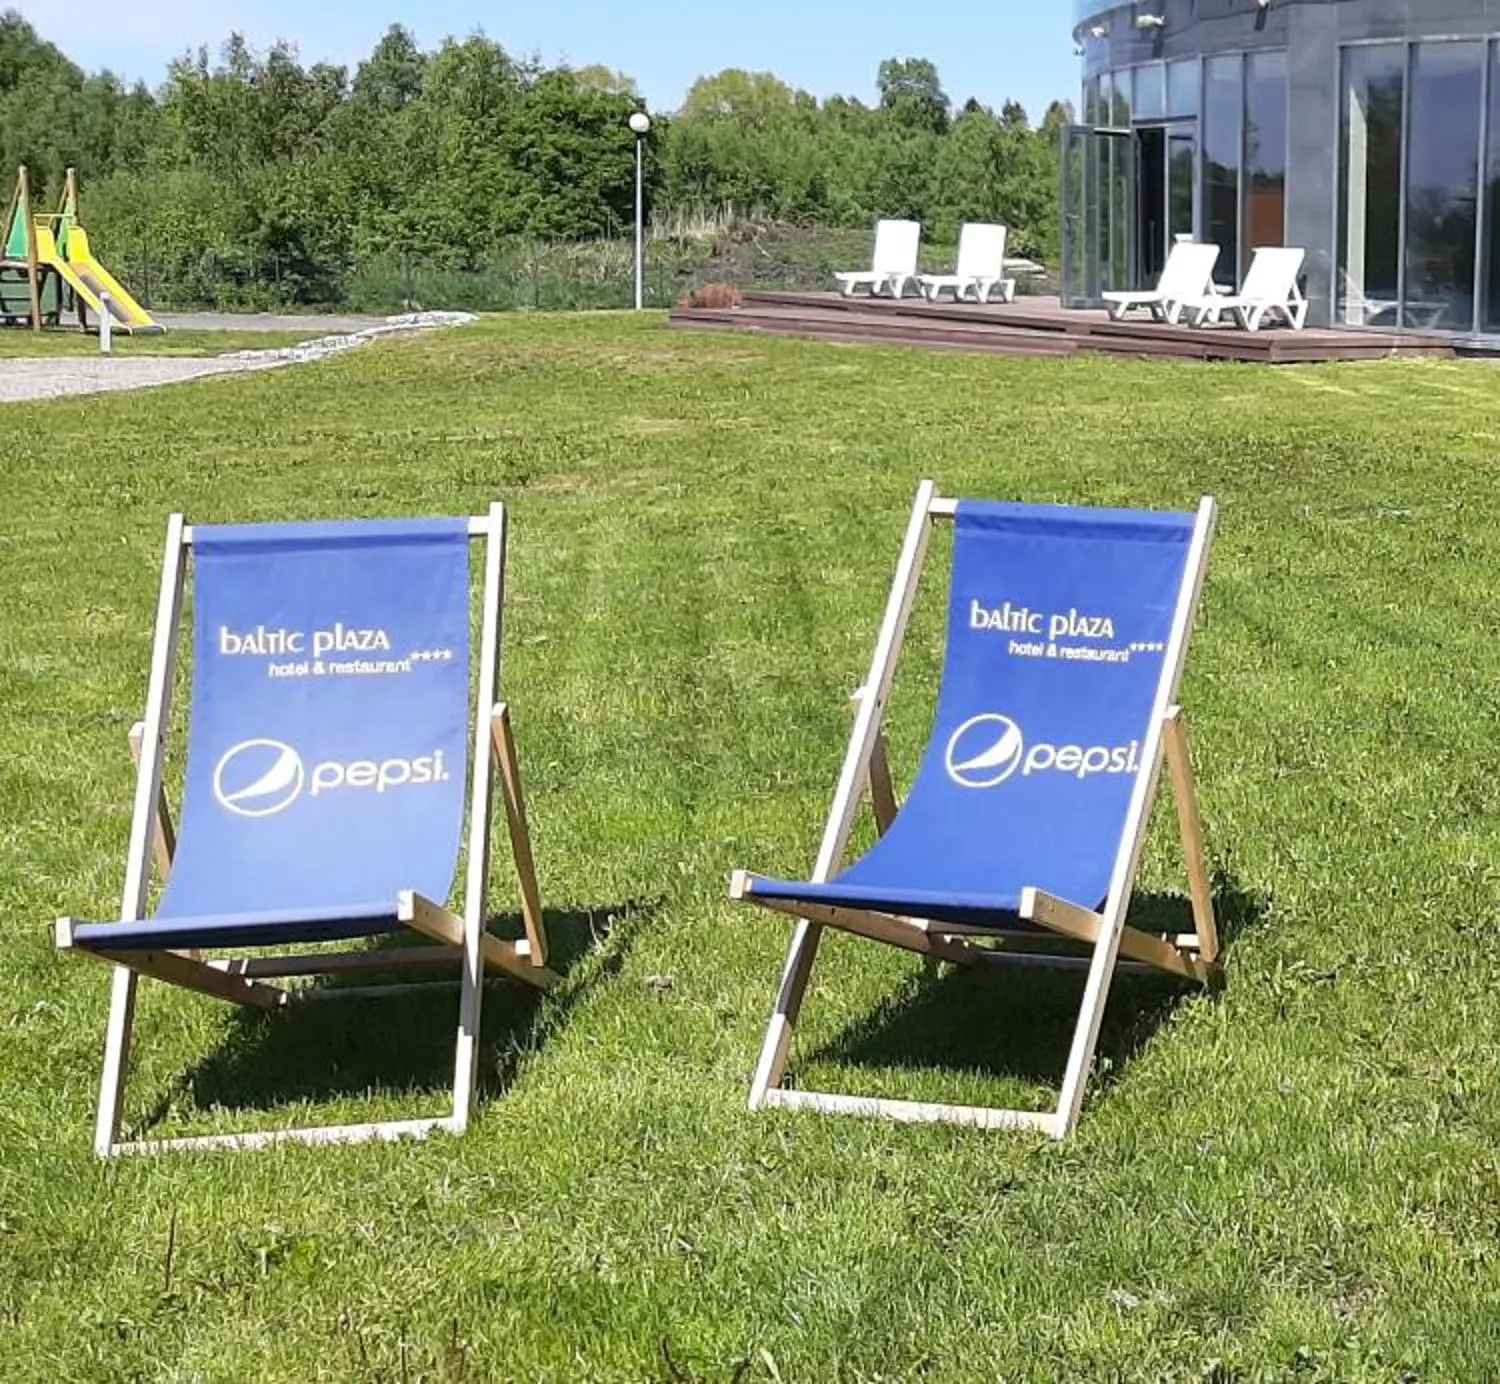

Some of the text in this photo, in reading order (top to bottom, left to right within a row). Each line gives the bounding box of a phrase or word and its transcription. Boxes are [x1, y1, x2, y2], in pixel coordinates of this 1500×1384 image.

[1008, 639, 1043, 657] hotel
[268, 661, 308, 678] hotel
[313, 660, 326, 675] &
